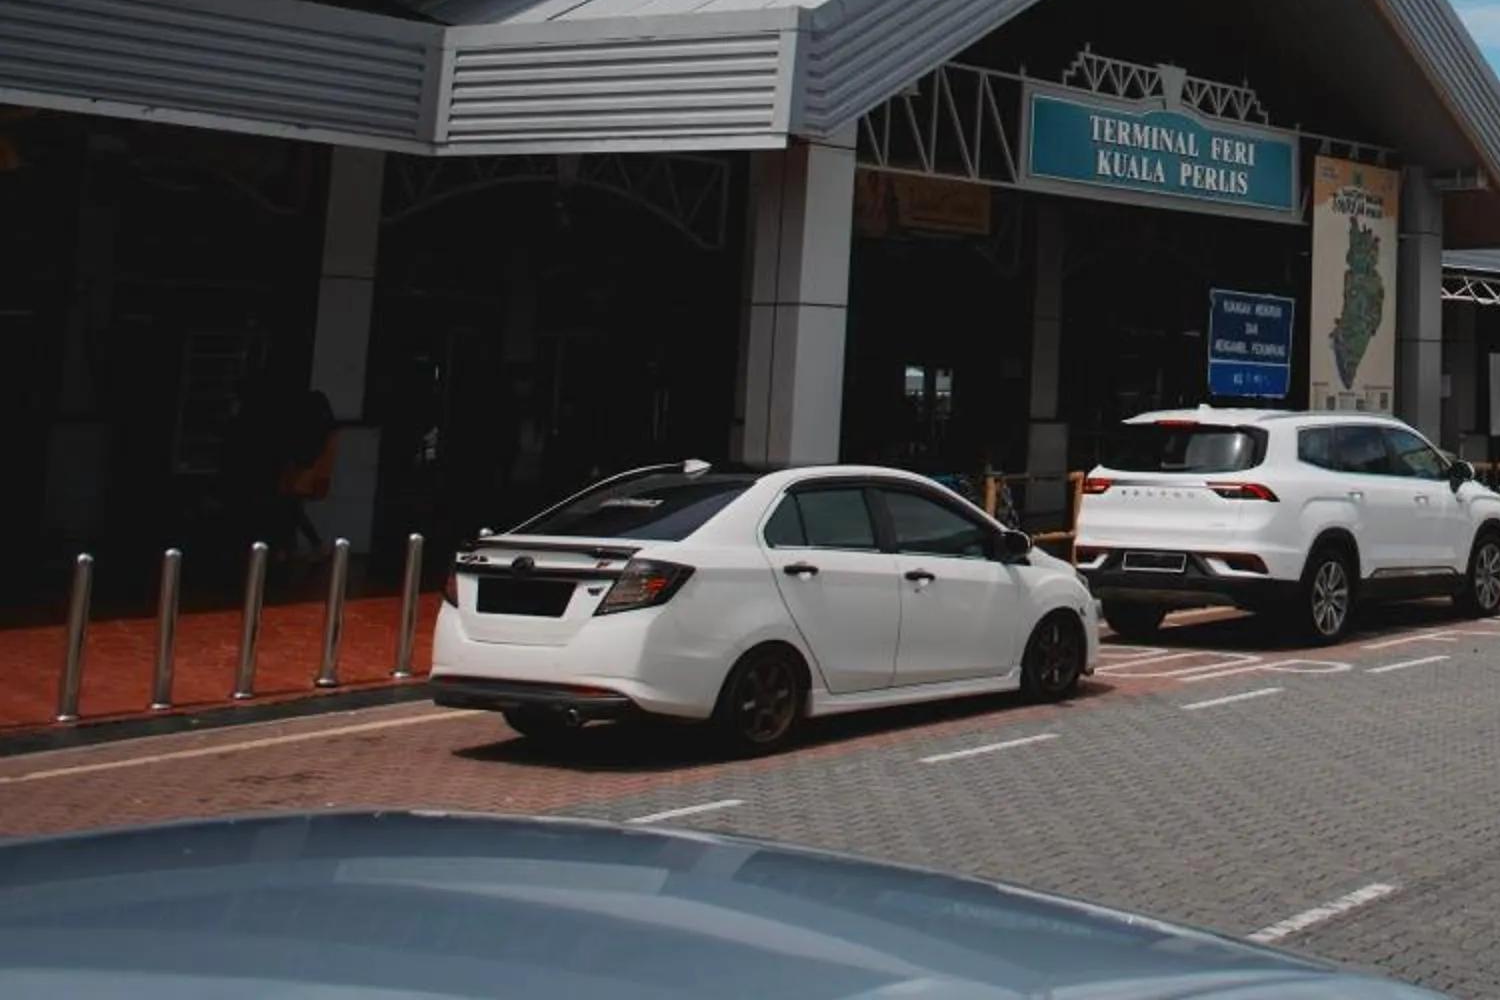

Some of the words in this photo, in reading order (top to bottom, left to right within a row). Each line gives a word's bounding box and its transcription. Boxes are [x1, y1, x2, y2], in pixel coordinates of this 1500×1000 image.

[1090, 115, 1199, 158] TERMINAL
[1210, 136, 1255, 166] FERI
[1097, 150, 1165, 183] KUALA
[1180, 163, 1248, 195] PERLIS
